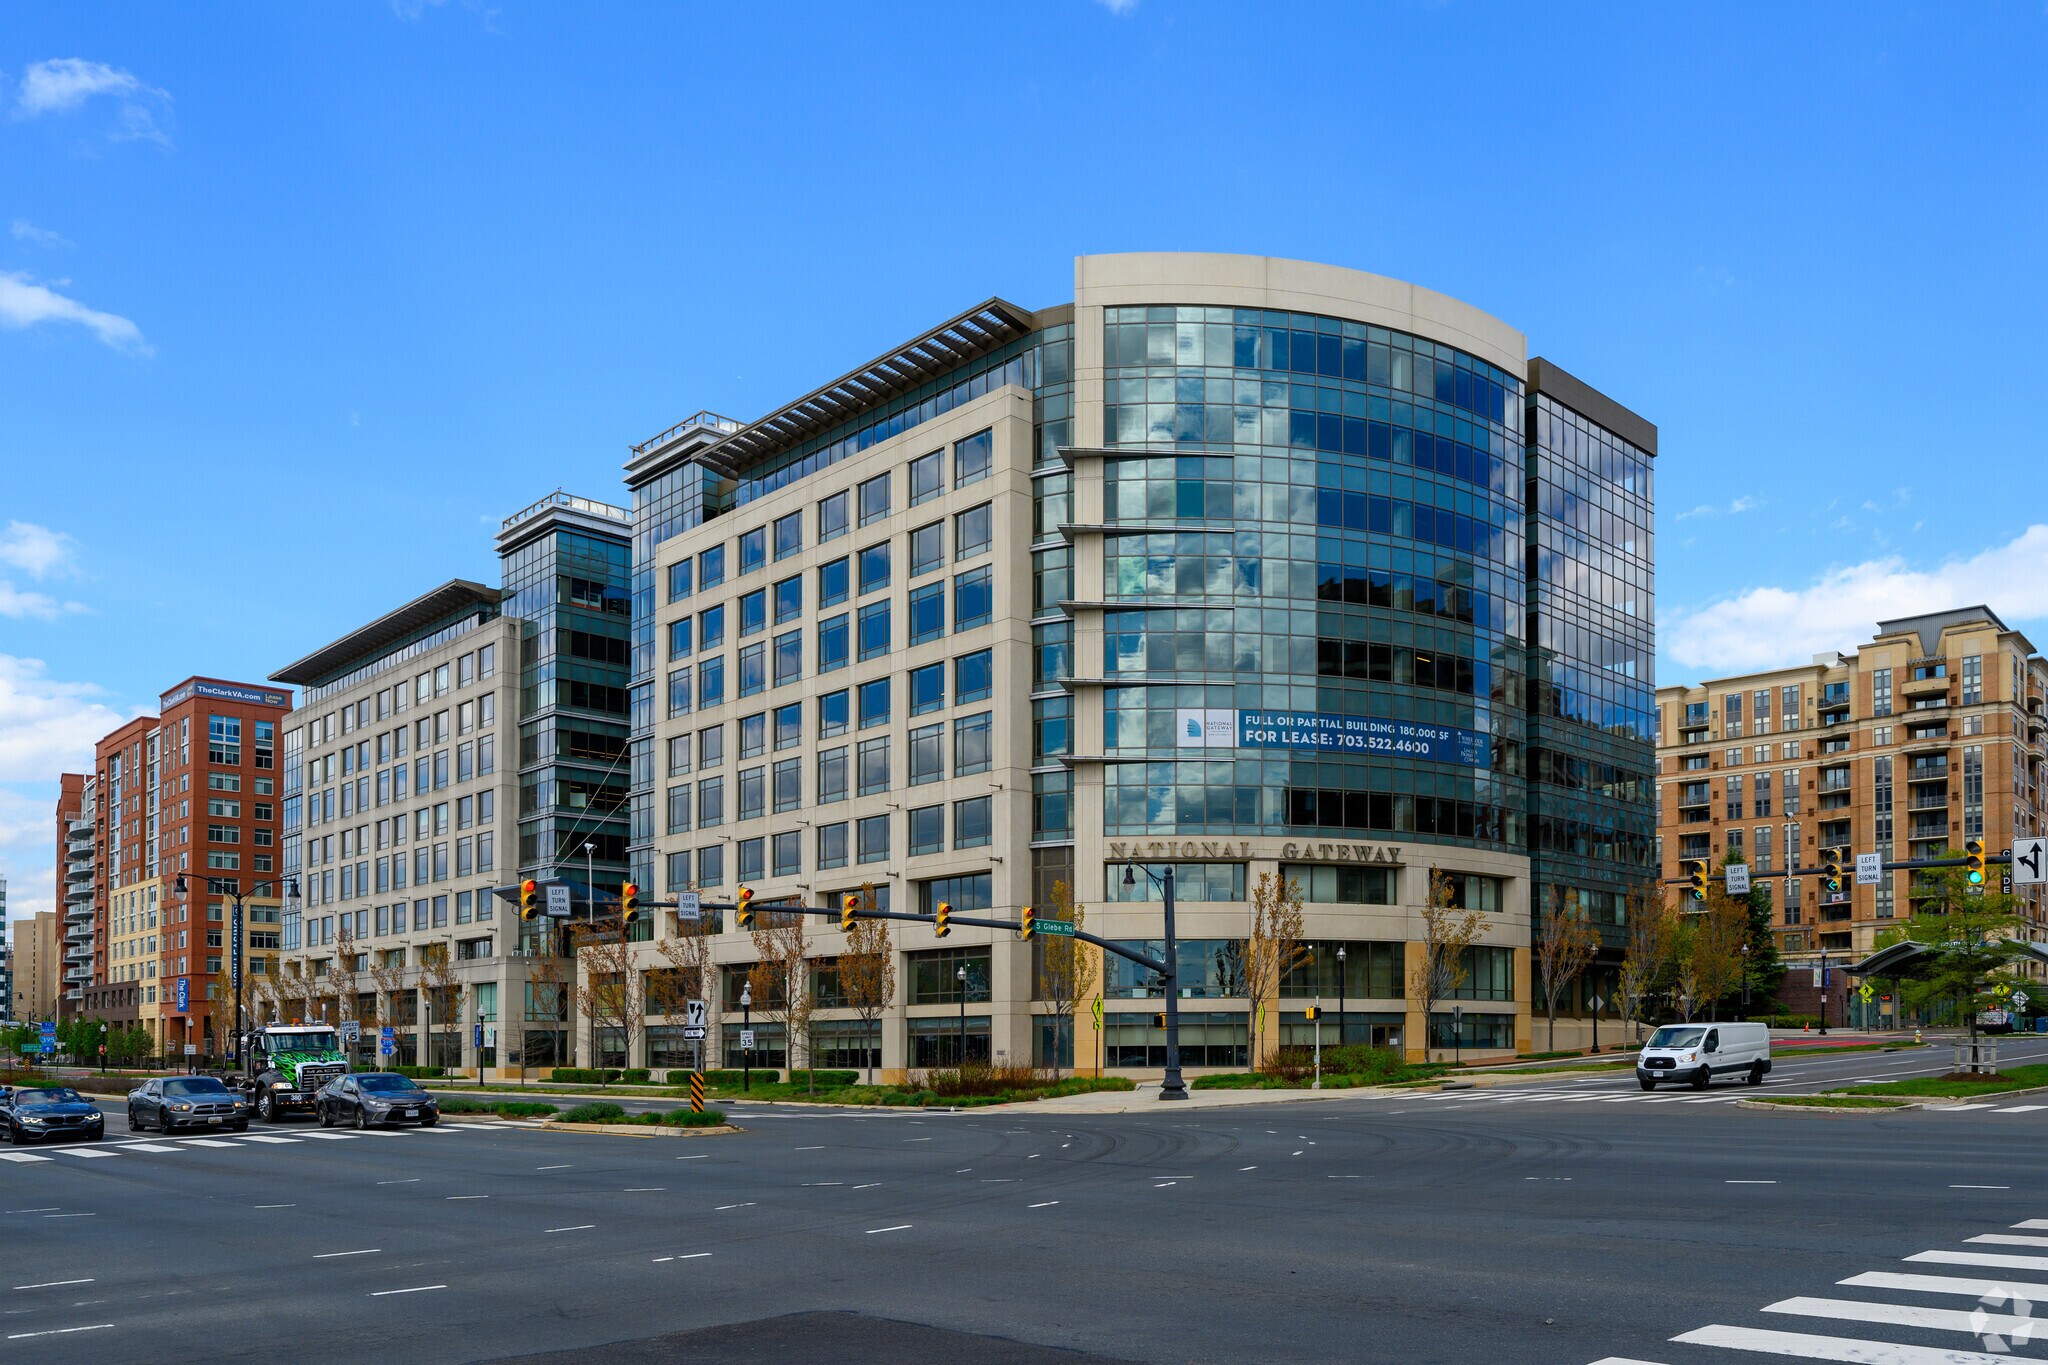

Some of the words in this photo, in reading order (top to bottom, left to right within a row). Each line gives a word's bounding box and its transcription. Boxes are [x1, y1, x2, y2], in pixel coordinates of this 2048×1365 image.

[197, 685, 261, 701] TheClarkVA.com
[1245, 715, 1274, 725] FULL
[1277, 716, 1294, 726] OR
[1297, 718, 1343, 729] PARTIAL
[1346, 721, 1395, 734] BUILDING
[1400, 726, 1436, 739] 180,000
[1439, 731, 1449, 740] SF
[1245, 730, 1277, 742] FOR
[1282, 731, 1333, 746] LEASE:
[1337, 734, 1429, 754] 703.522.4600
[1109, 841, 1255, 858] NATIONAL
[1282, 842, 1401, 863] GATEWAY
[1861, 856, 1875, 864] LEFT
[1036, 922, 1041, 930] S
[1043, 923, 1062, 931] Glebe
[1064, 925, 1073, 933] Rd
[178, 992, 186, 1008] Clark
[741, 1039, 753, 1047] 35
